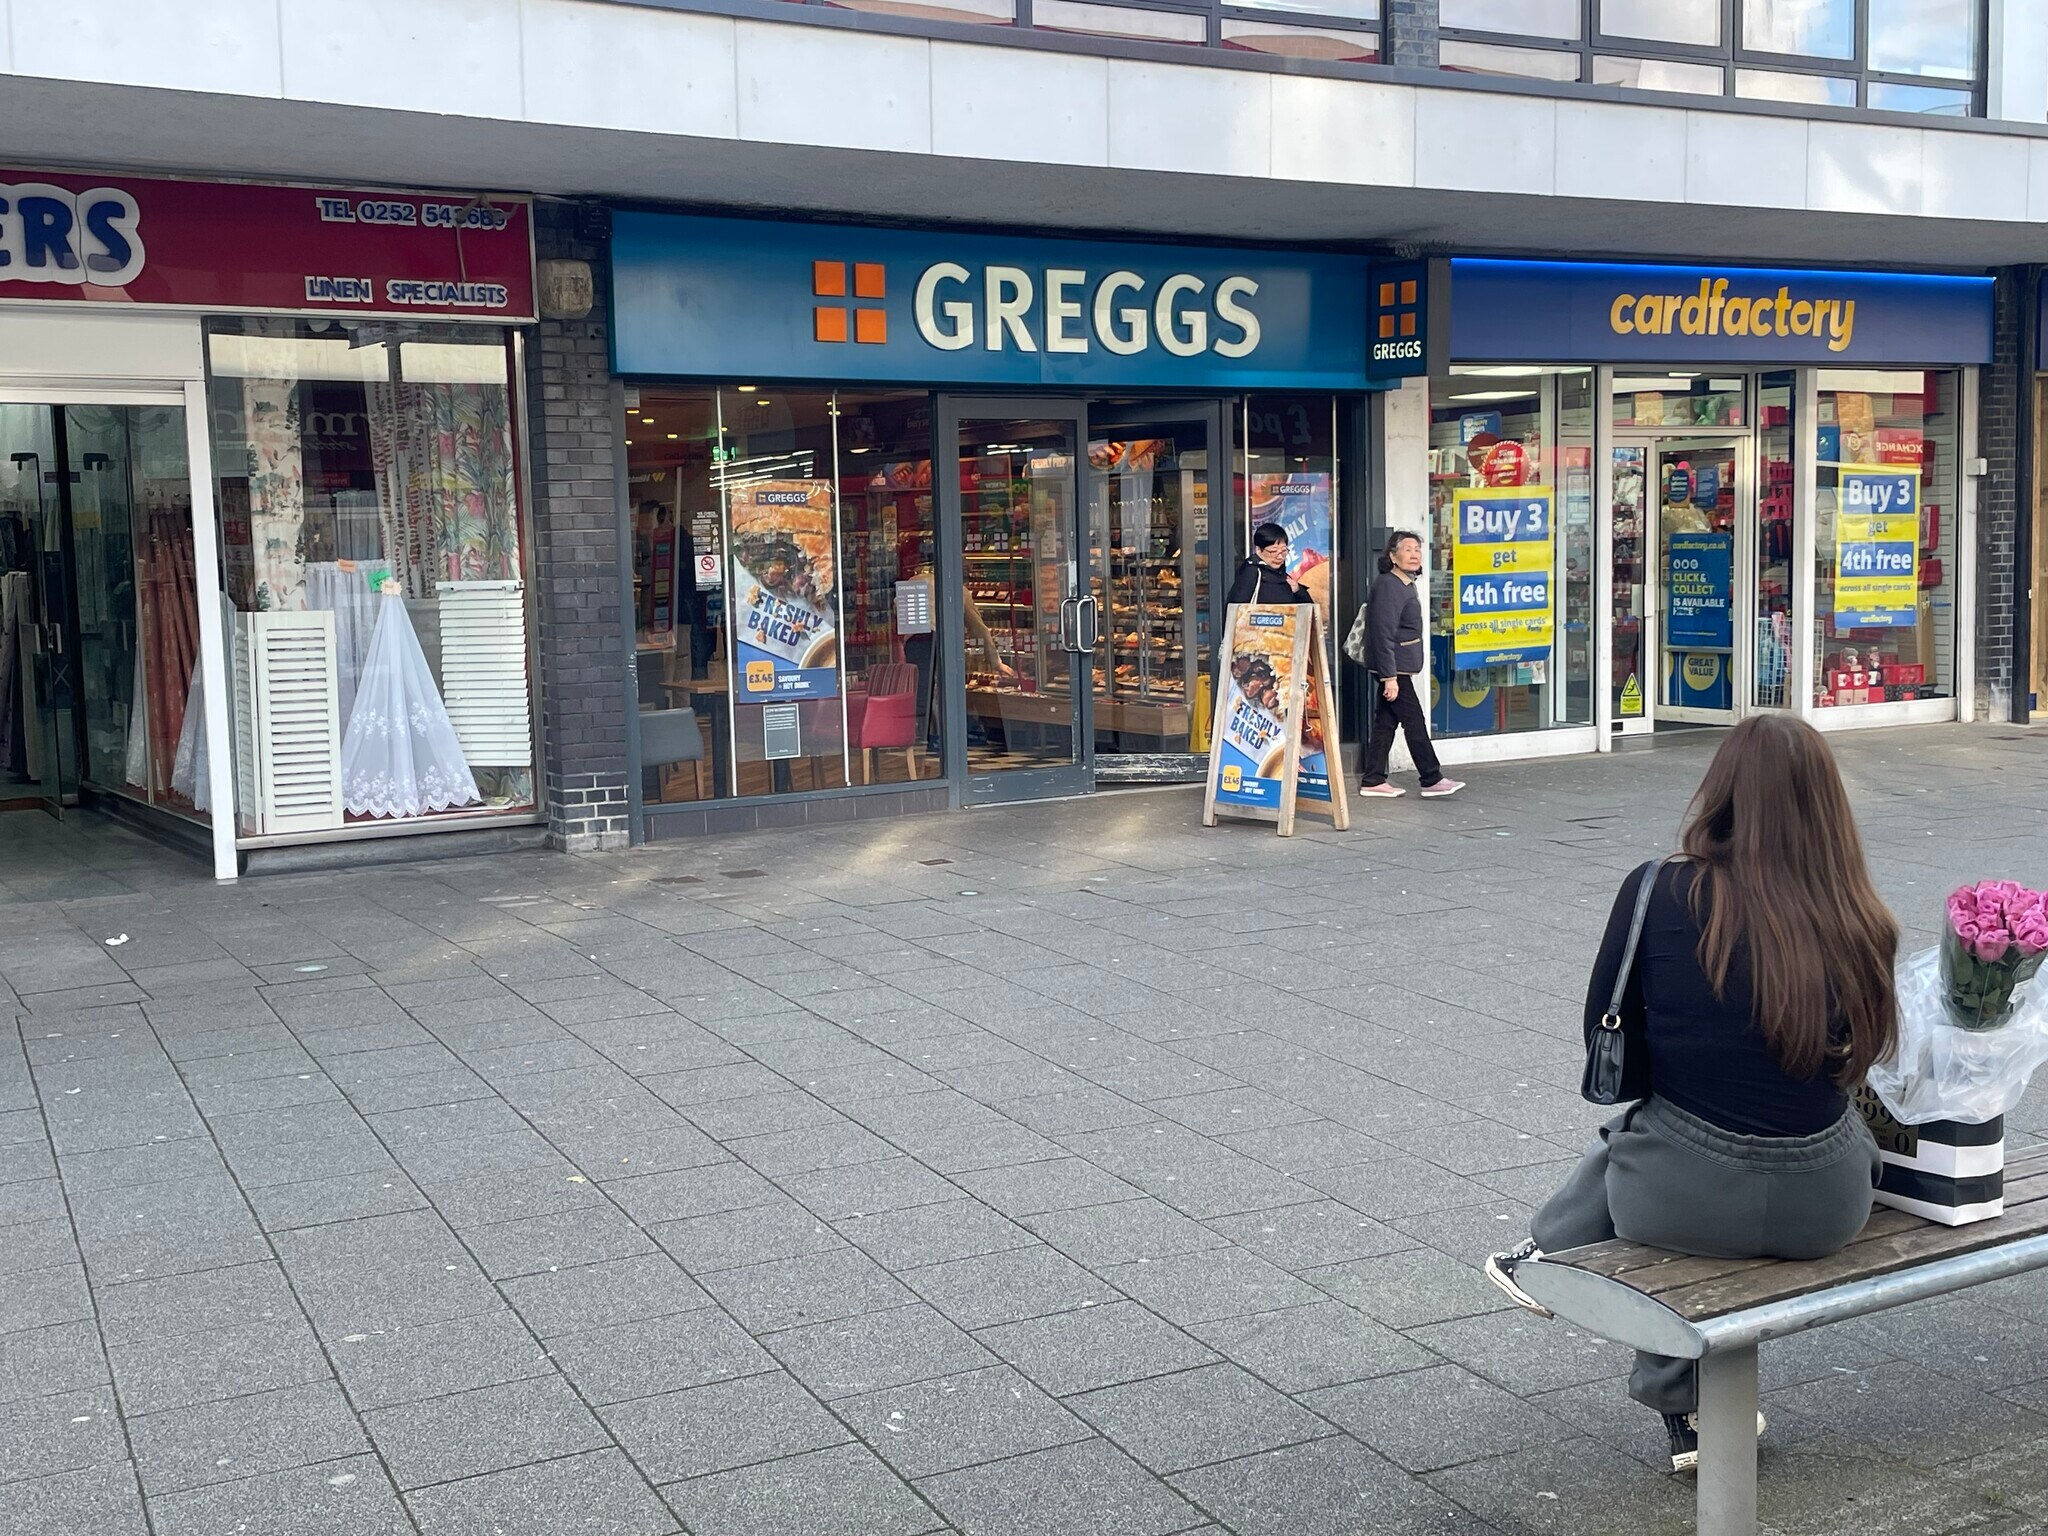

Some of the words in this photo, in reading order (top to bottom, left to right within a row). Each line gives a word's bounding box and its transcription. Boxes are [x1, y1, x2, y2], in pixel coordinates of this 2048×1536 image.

[319, 199, 354, 219] TEL
[359, 201, 416, 223] 0252
[307, 276, 371, 300] LINEN
[389, 280, 507, 306] SPECIALISTS
[914, 261, 1261, 358] GREGGS
[1610, 278, 1855, 351] cardfactory
[1373, 340, 1422, 360] GREGGS
[767, 493, 807, 503] GREGGS
[1279, 485, 1311, 494] GREGGS
[1849, 479, 1893, 513] Buy
[1896, 479, 1911, 505] 3
[1467, 505, 1521, 541] Buy
[1525, 503, 1542, 532] 3
[1868, 520, 1888, 536] get
[1492, 550, 1517, 568] get
[1841, 549, 1872, 570] 4th
[1876, 549, 1912, 570] free
[1673, 572, 1699, 582] CLICK
[1462, 582, 1498, 606] 4th
[1502, 580, 1546, 604] free
[1673, 584, 1715, 595] COLLECT
[1839, 584, 1862, 592] across
[1863, 583, 1871, 591] all
[1872, 583, 1892, 593] single
[757, 591, 824, 631] FRESHLY
[1673, 597, 1681, 606] IS
[1681, 598, 1725, 608] AVAILABLE
[747, 610, 801, 647] BAKED
[1256, 616, 1283, 625] GREGGS
[1460, 621, 1488, 631] across
[1489, 619, 1499, 629] all
[1500, 618, 1523, 629] single
[1688, 657, 1714, 667] GREAT
[748, 673, 774, 684] £3.45
[1688, 667, 1714, 677] VALUE
[1236, 702, 1282, 738] FRESHLY
[1230, 716, 1264, 750] BAKED
[1223, 775, 1240, 785] £3.45
